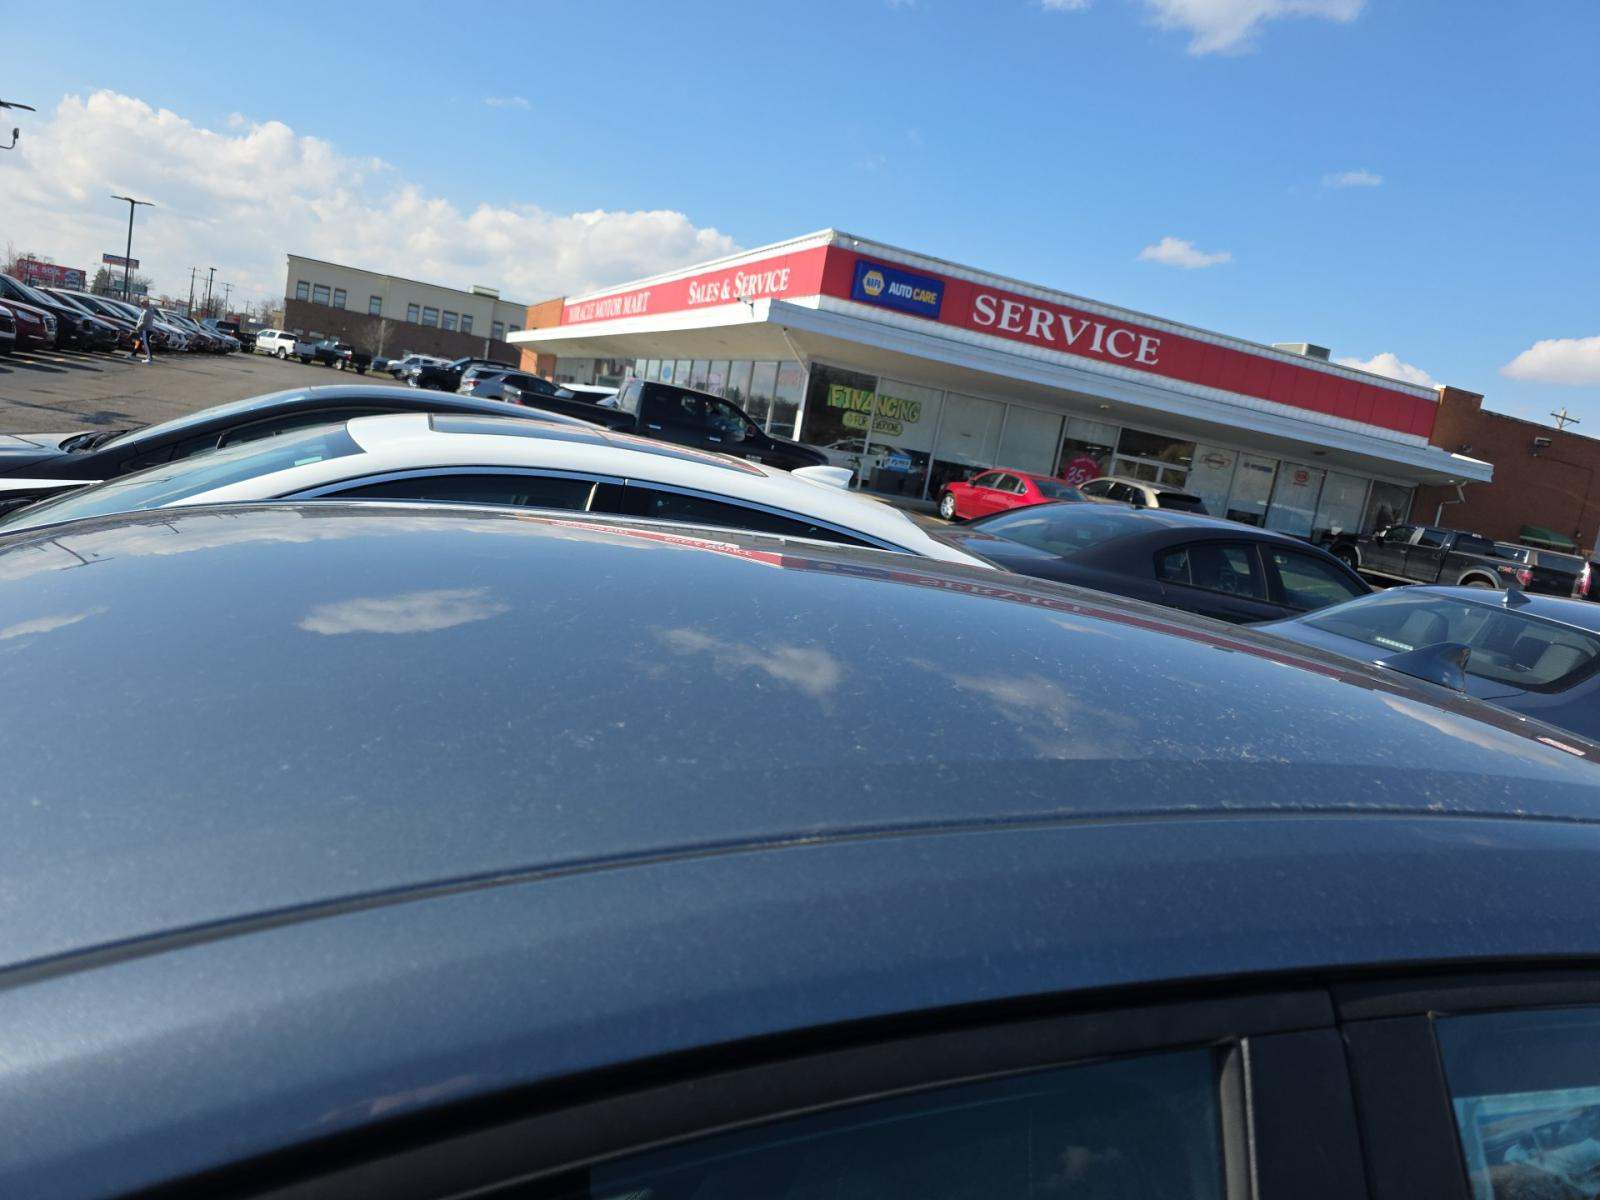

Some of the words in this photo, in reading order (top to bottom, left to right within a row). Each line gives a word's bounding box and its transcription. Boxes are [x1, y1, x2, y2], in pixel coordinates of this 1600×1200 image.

[720, 277, 731, 300] &
[733, 267, 790, 298] SERVICE
[888, 281, 913, 299] AUTO
[912, 288, 938, 305] CARE
[623, 291, 651, 315] MART
[973, 294, 1161, 365] SERVICE
[828, 384, 921, 423] FINANCING
